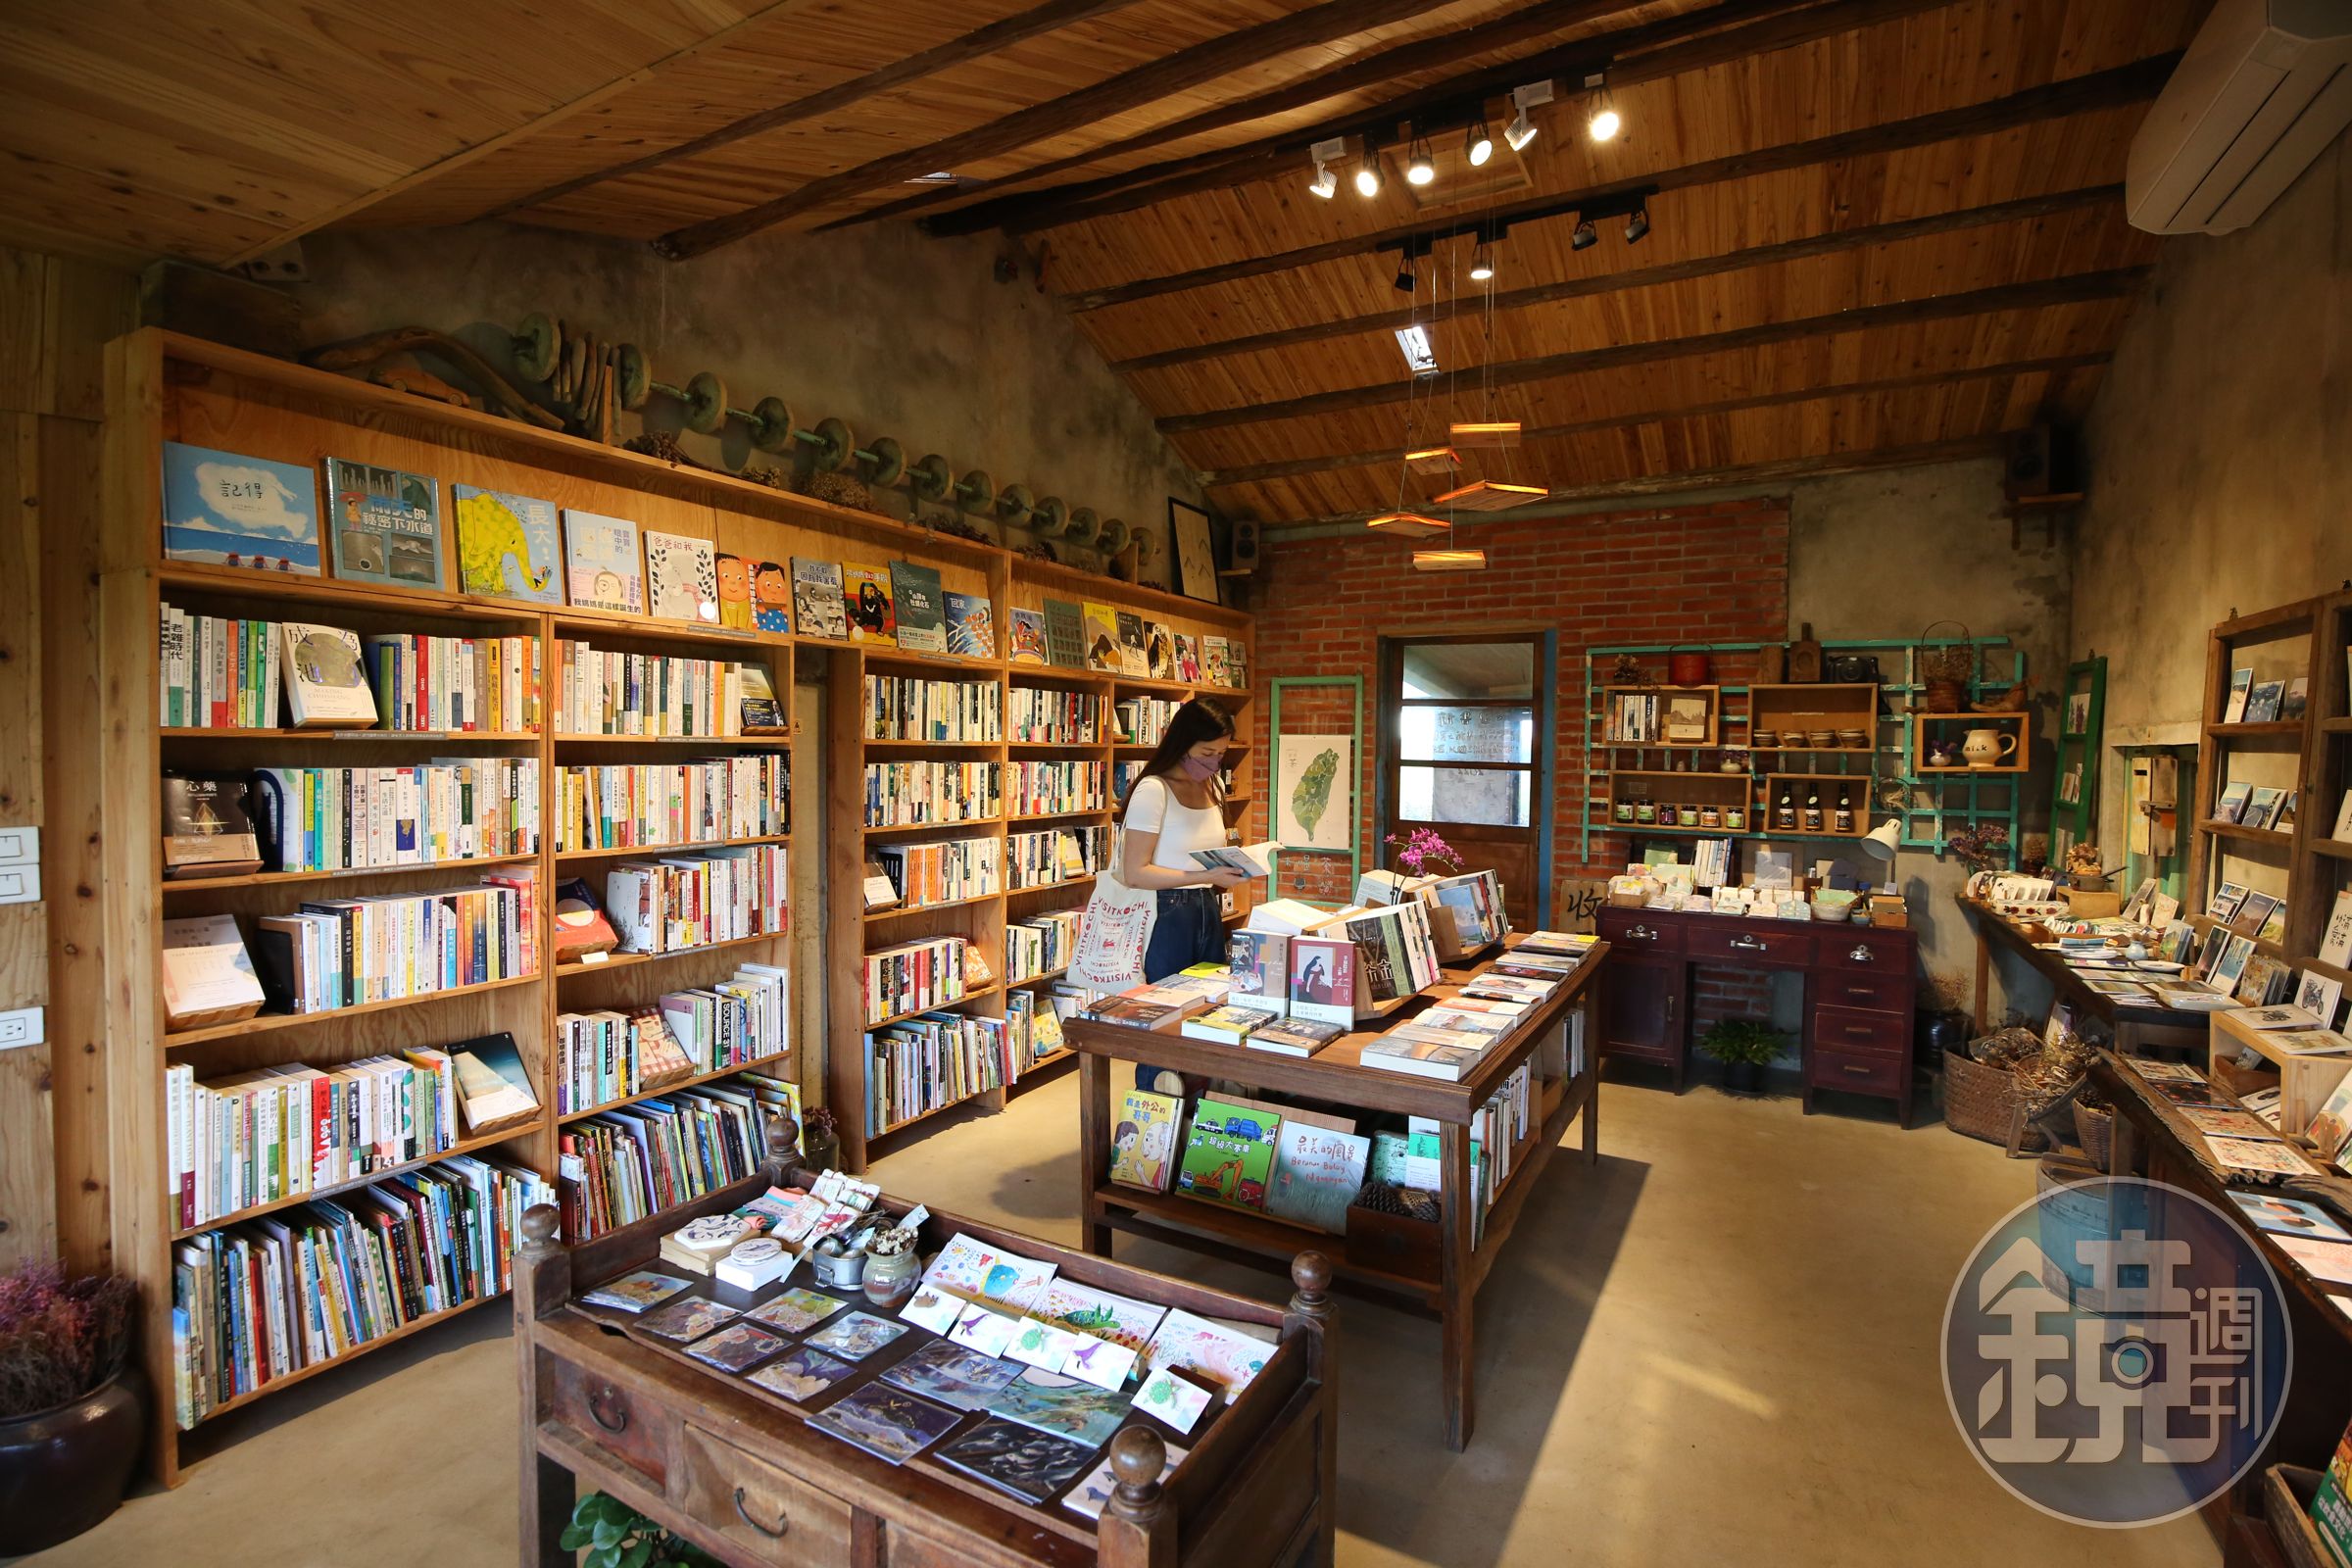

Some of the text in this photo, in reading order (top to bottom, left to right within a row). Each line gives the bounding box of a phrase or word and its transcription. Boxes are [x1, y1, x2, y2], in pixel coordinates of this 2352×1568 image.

[220, 479, 263, 499] 記得
[653, 535, 694, 552] 爸爸和我
[573, 598, 642, 613] 我媽媽是這樣誕生的
[1098, 897, 1149, 915] VISITKOCHI
[1076, 903, 1098, 966] VISITKOCHI
[1297, 1135, 1355, 1160] 最美的風景
